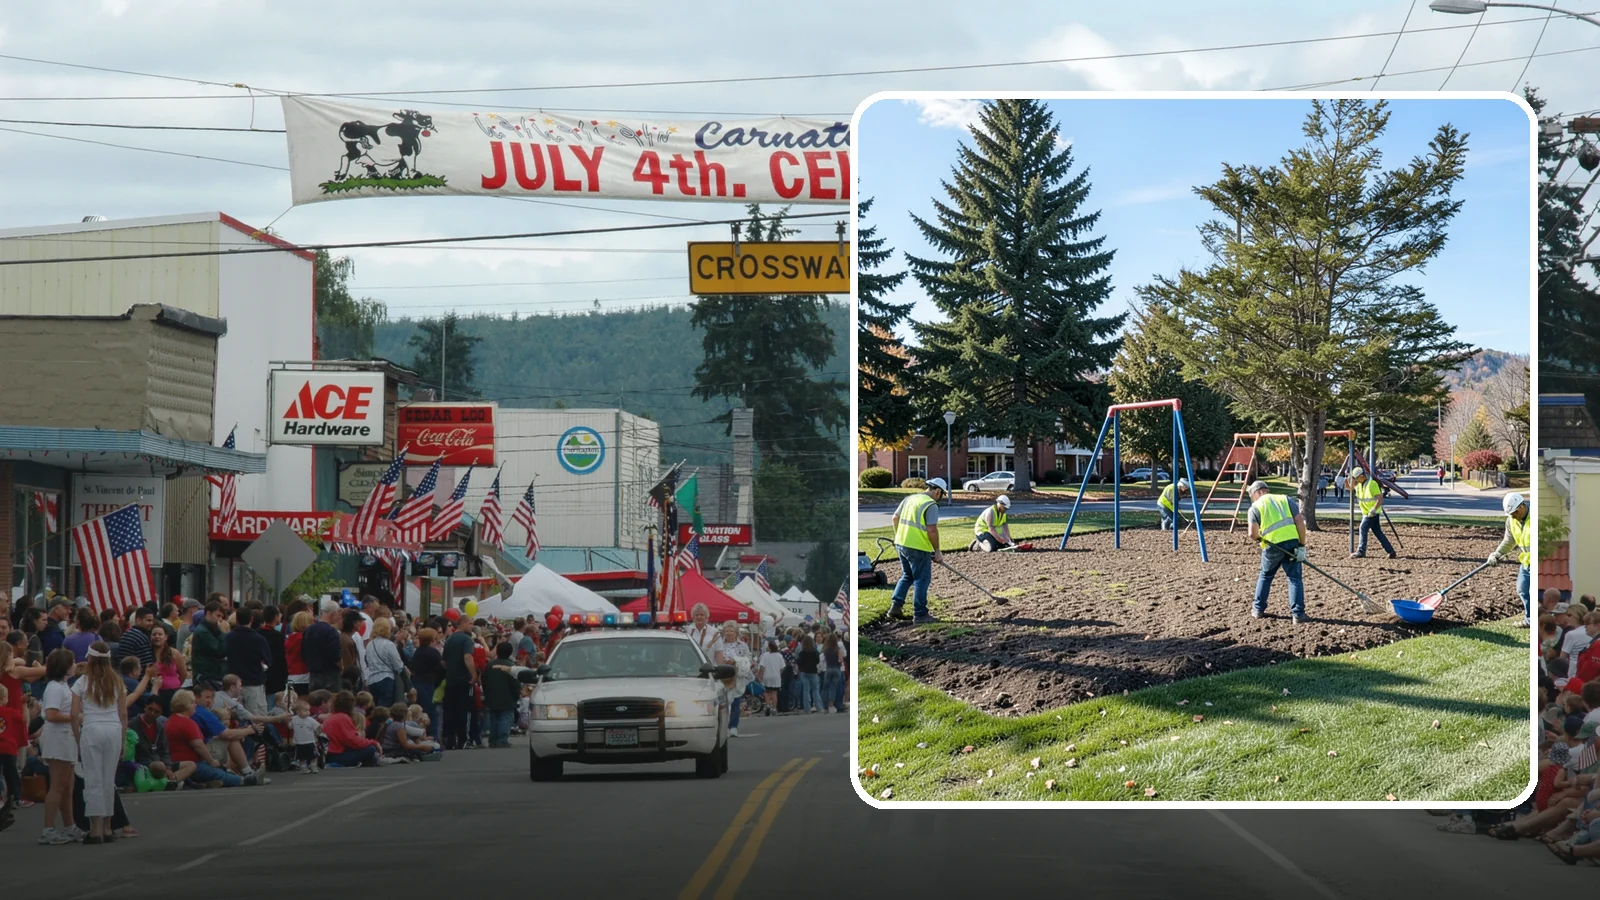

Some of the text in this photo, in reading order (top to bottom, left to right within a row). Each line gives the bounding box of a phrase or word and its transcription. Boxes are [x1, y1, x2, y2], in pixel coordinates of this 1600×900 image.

[695, 121, 850, 149] Carnat
[481, 141, 605, 192] JULY
[632, 150, 746, 197] 4th.
[697, 254, 850, 280] CROSSWA
[283, 380, 373, 420] ACE
[405, 409, 485, 422] CEDAR LOG
[283, 421, 371, 436] Hardware
[416, 428, 477, 447] Coca-Cola
[95, 485, 124, 495] Vincent
[126, 485, 135, 495] de
[137, 486, 155, 495] Paul
[212, 516, 330, 535] HARDARE
[688, 526, 741, 535] CRNATION
[699, 535, 730, 543] GLASS
